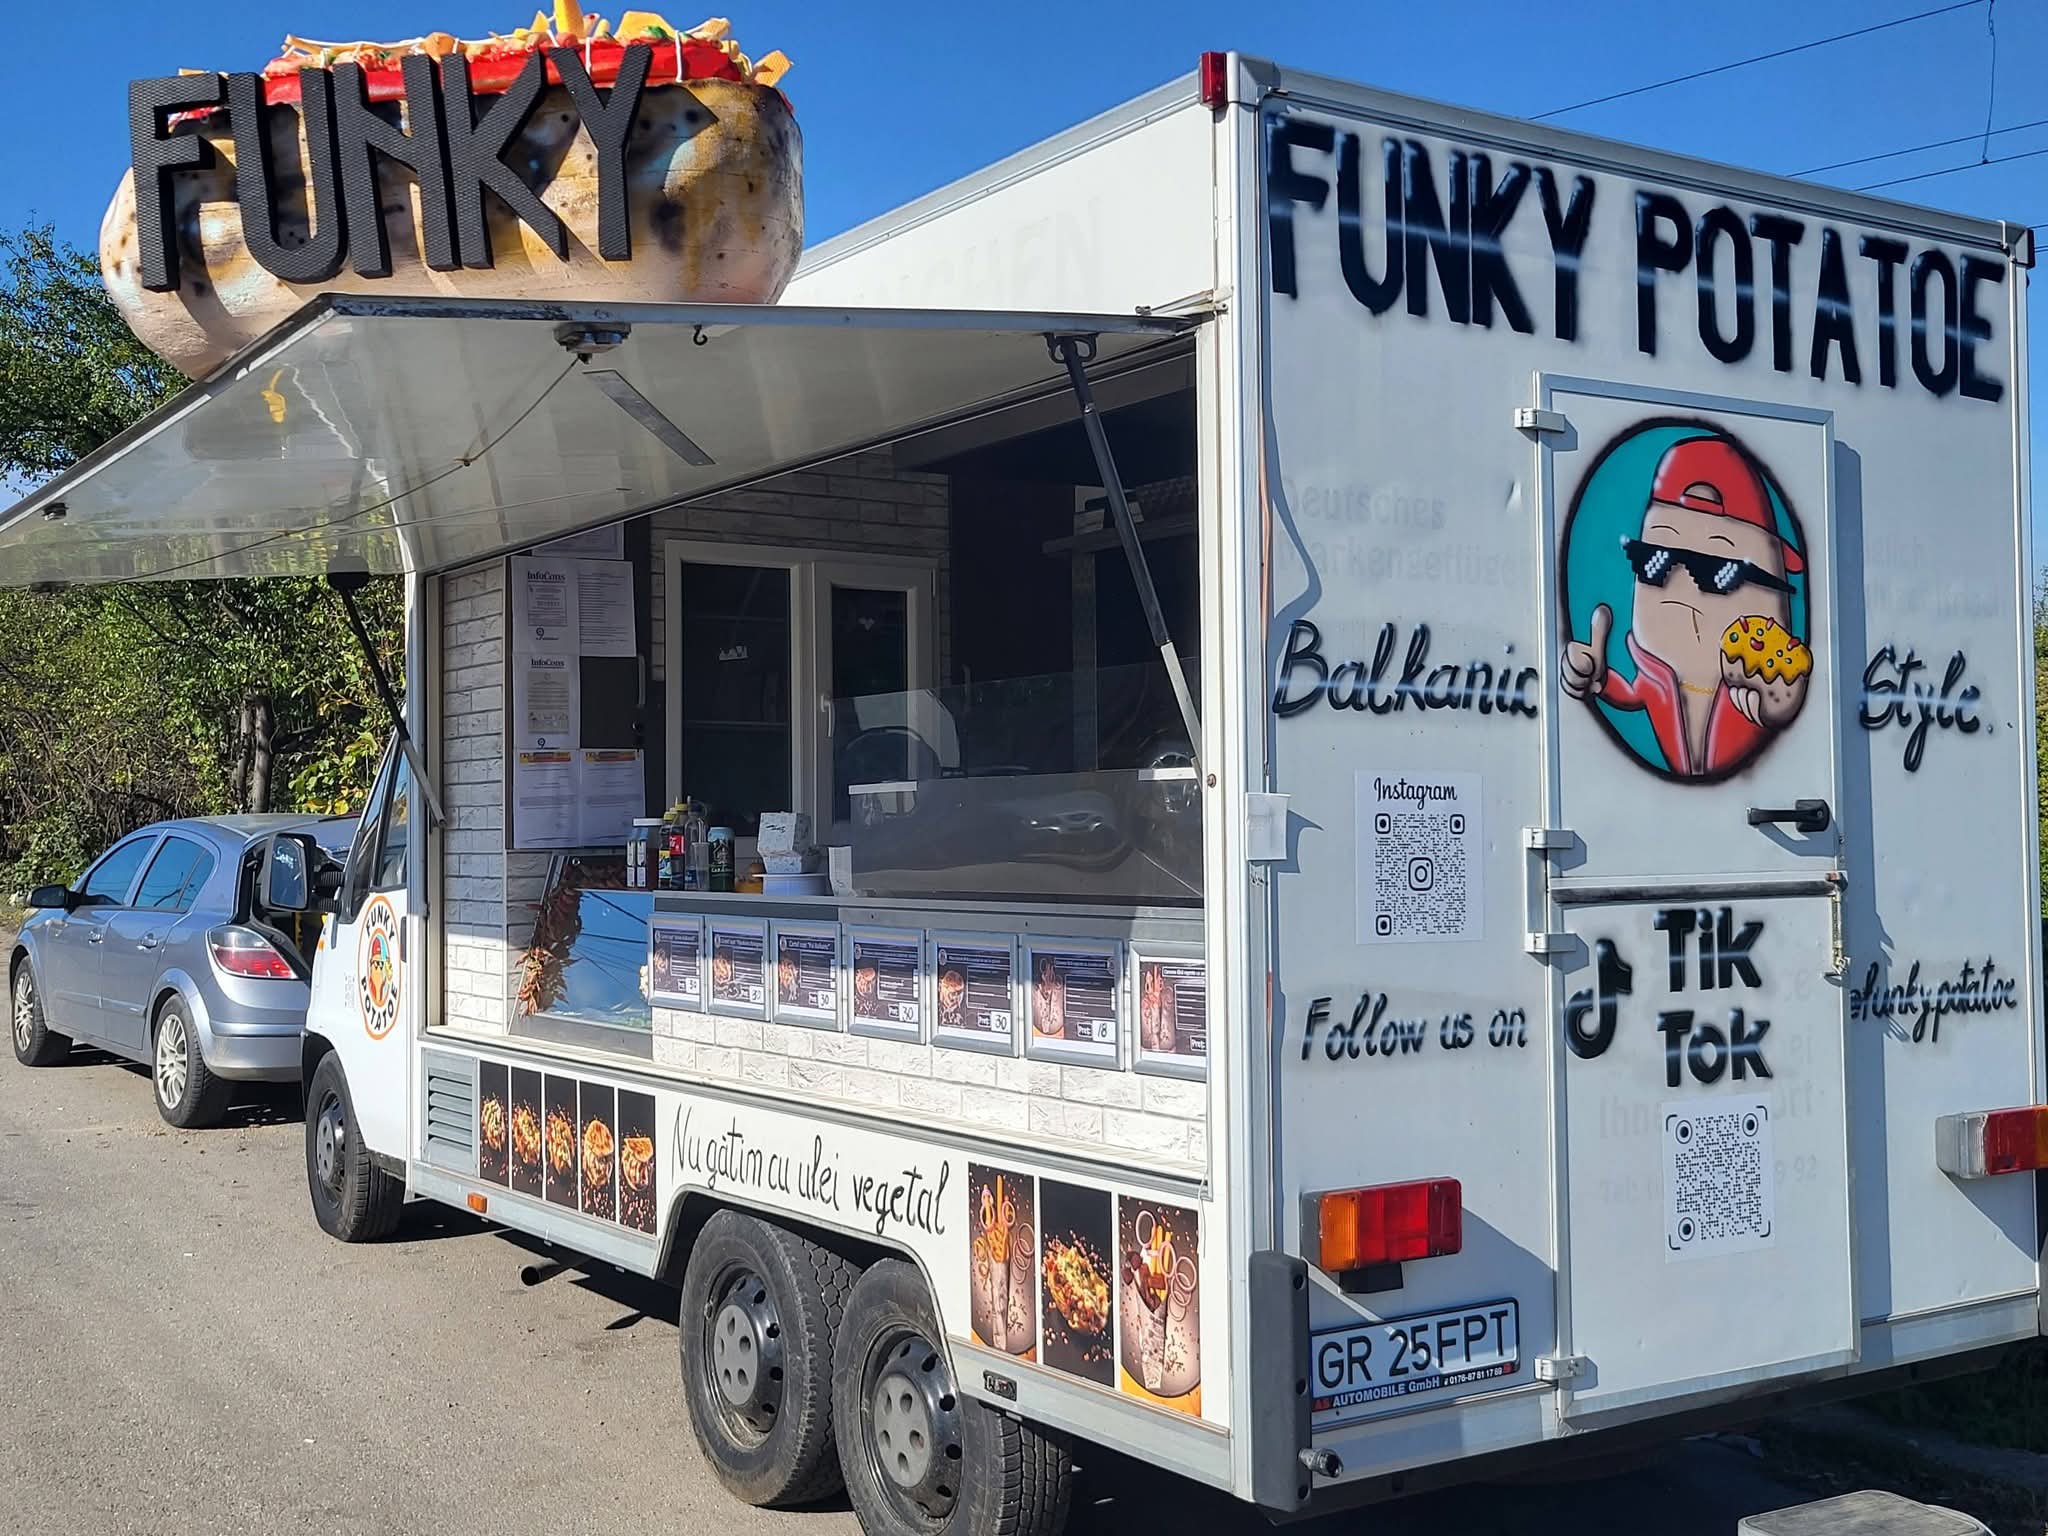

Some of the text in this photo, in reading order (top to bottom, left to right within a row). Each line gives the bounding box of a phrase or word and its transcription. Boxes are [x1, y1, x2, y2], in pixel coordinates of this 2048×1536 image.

[128, 43, 652, 292] FUNKY
[1266, 112, 1597, 343] FUNKY
[1635, 188, 2006, 402] POTATOE
[527, 570, 566, 582] InfoCons
[1271, 618, 1540, 720] Balkanic
[1373, 776, 1458, 811] Instagram
[365, 903, 396, 941] FUNKY
[1653, 905, 1765, 993] Tik
[360, 975, 398, 1031] POTATOE
[820, 994, 830, 1008] 30
[902, 1006, 914, 1021] 30
[995, 1015, 1007, 1031] 30
[1300, 990, 1528, 1061] Follow us on
[1098, 1023, 1107, 1037] 18
[1656, 1007, 1774, 1088] Tok
[671, 1103, 702, 1185] Nu
[768, 1152, 790, 1195] cu
[798, 1135, 840, 1212] ulei
[853, 1160, 950, 1236] vegetal
[1318, 1335, 1373, 1389] GR
[1332, 1383, 1405, 1407] AUTOMOBILE
[1408, 1376, 1441, 1392] GmbH
